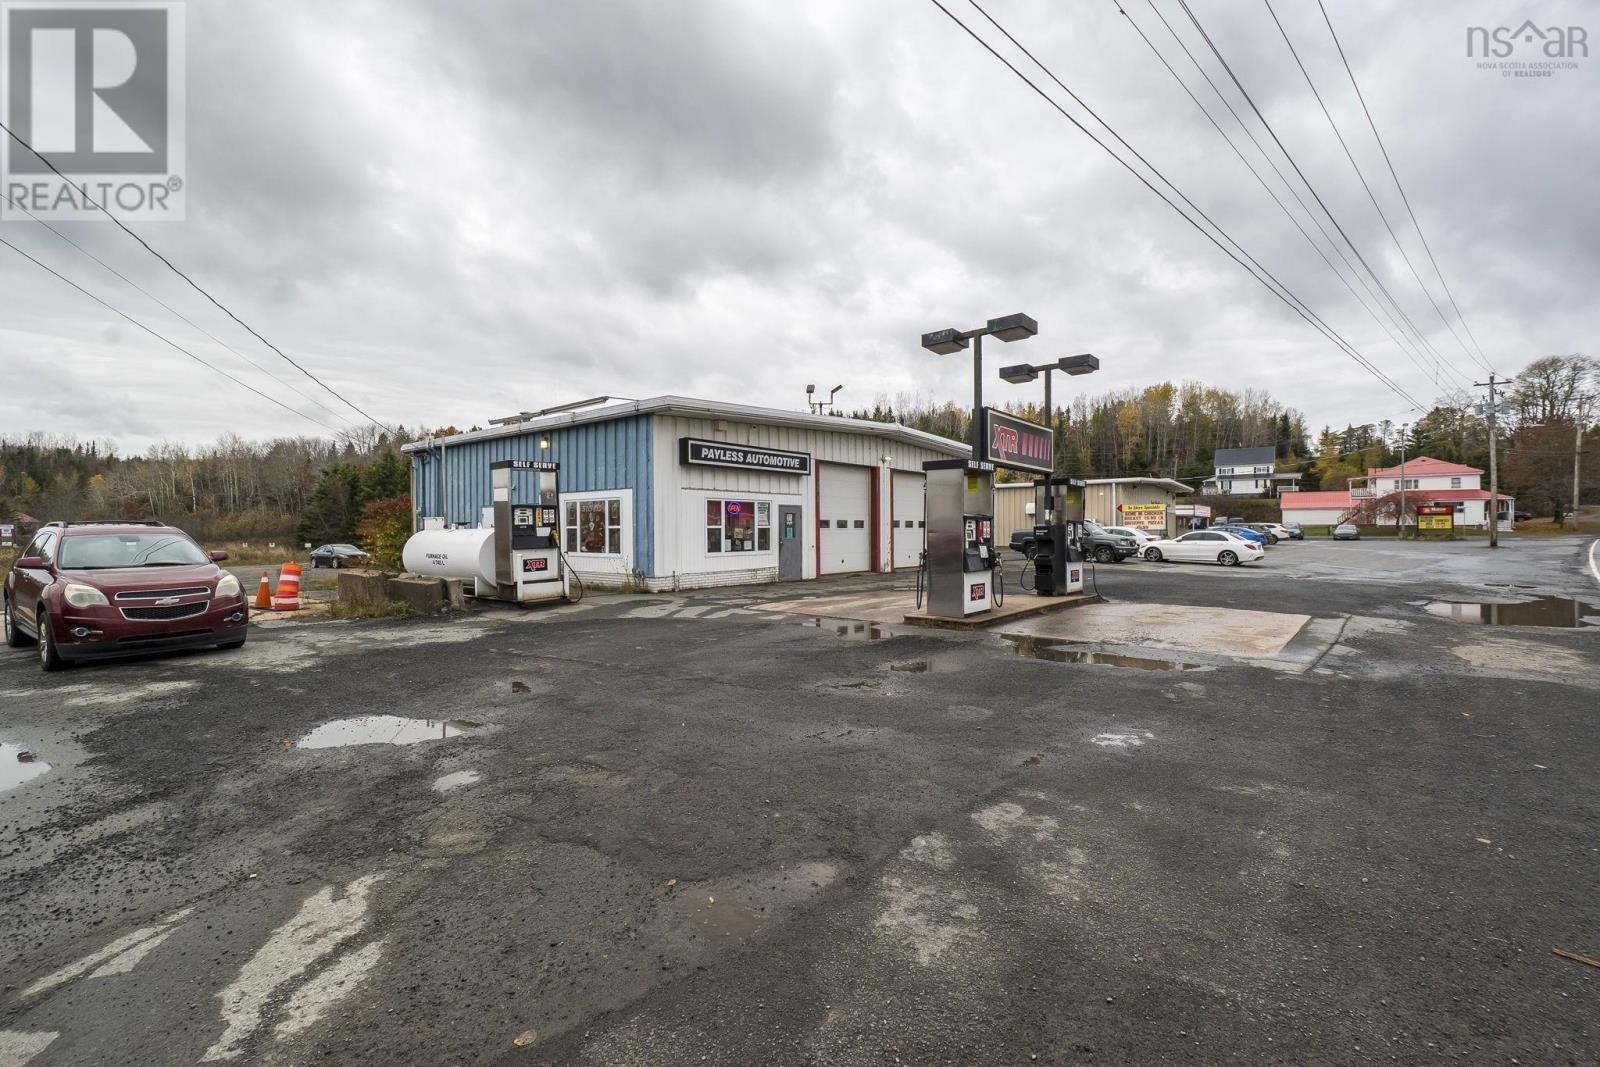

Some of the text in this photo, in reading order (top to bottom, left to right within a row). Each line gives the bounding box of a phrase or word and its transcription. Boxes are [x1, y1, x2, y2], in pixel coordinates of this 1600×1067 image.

[701, 448, 800, 468] PAYLESS AUTOMOTIVE
[513, 460, 531, 468] SELF
[968, 460, 994, 471] SELF SERVE
